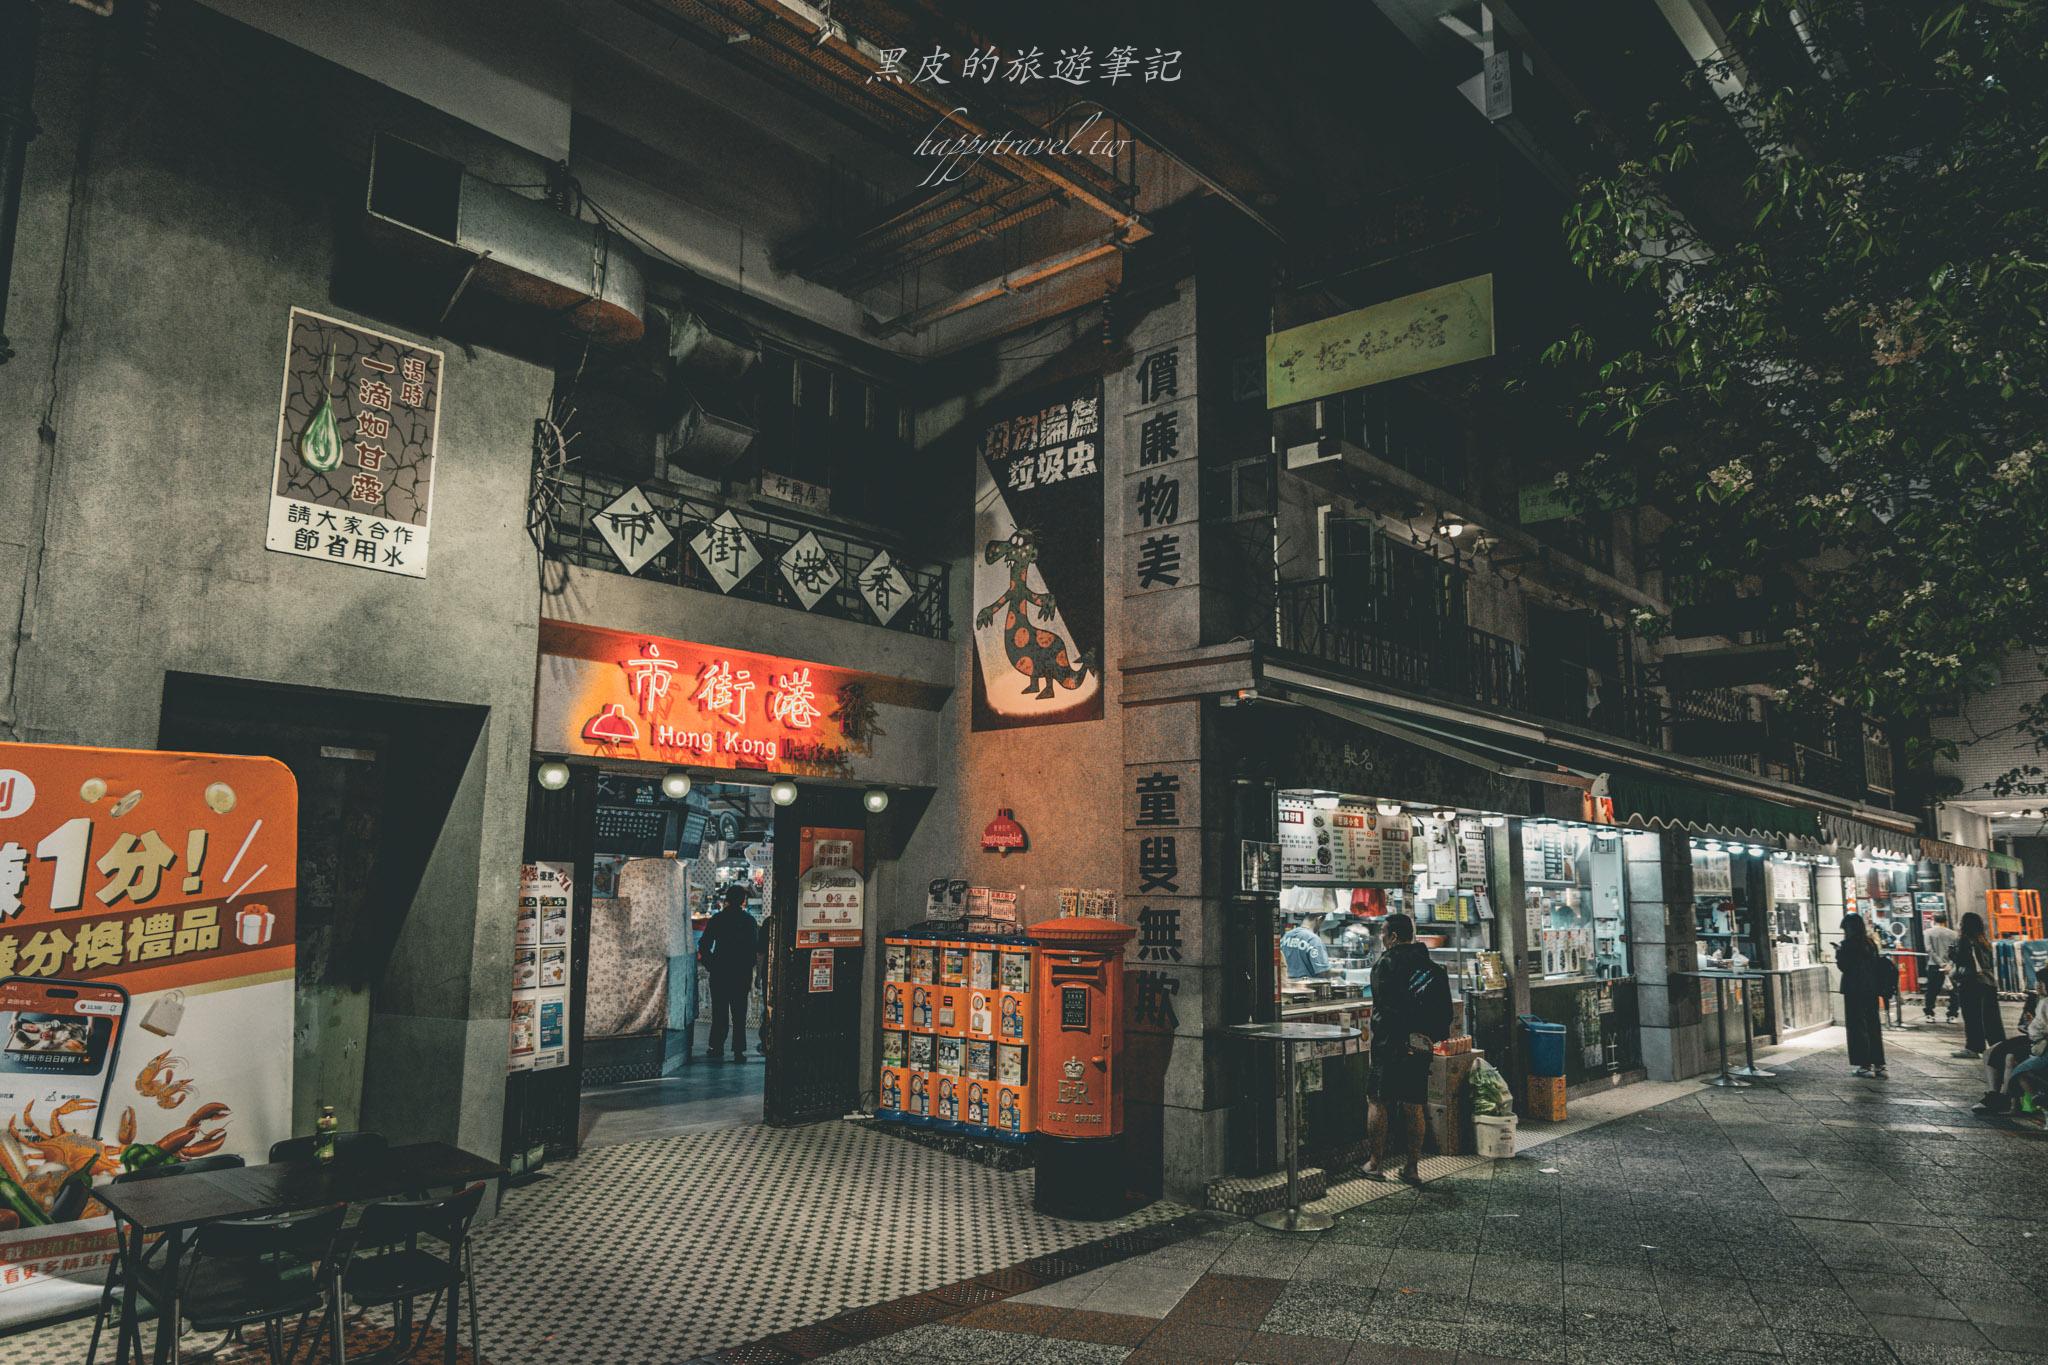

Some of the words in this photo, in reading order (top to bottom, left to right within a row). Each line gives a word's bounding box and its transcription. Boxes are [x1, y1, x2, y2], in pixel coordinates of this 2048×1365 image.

[401, 357, 426, 408] 渴時
[351, 357, 396, 505] 一滴如甘露
[1135, 345, 1181, 589] 價廉物美
[287, 503, 414, 545] 請大家合作
[293, 527, 405, 568] 節省用水
[656, 725, 713, 753] Hong
[724, 731, 777, 762] Kong
[1074, 1113, 1102, 1124] OFFICE
